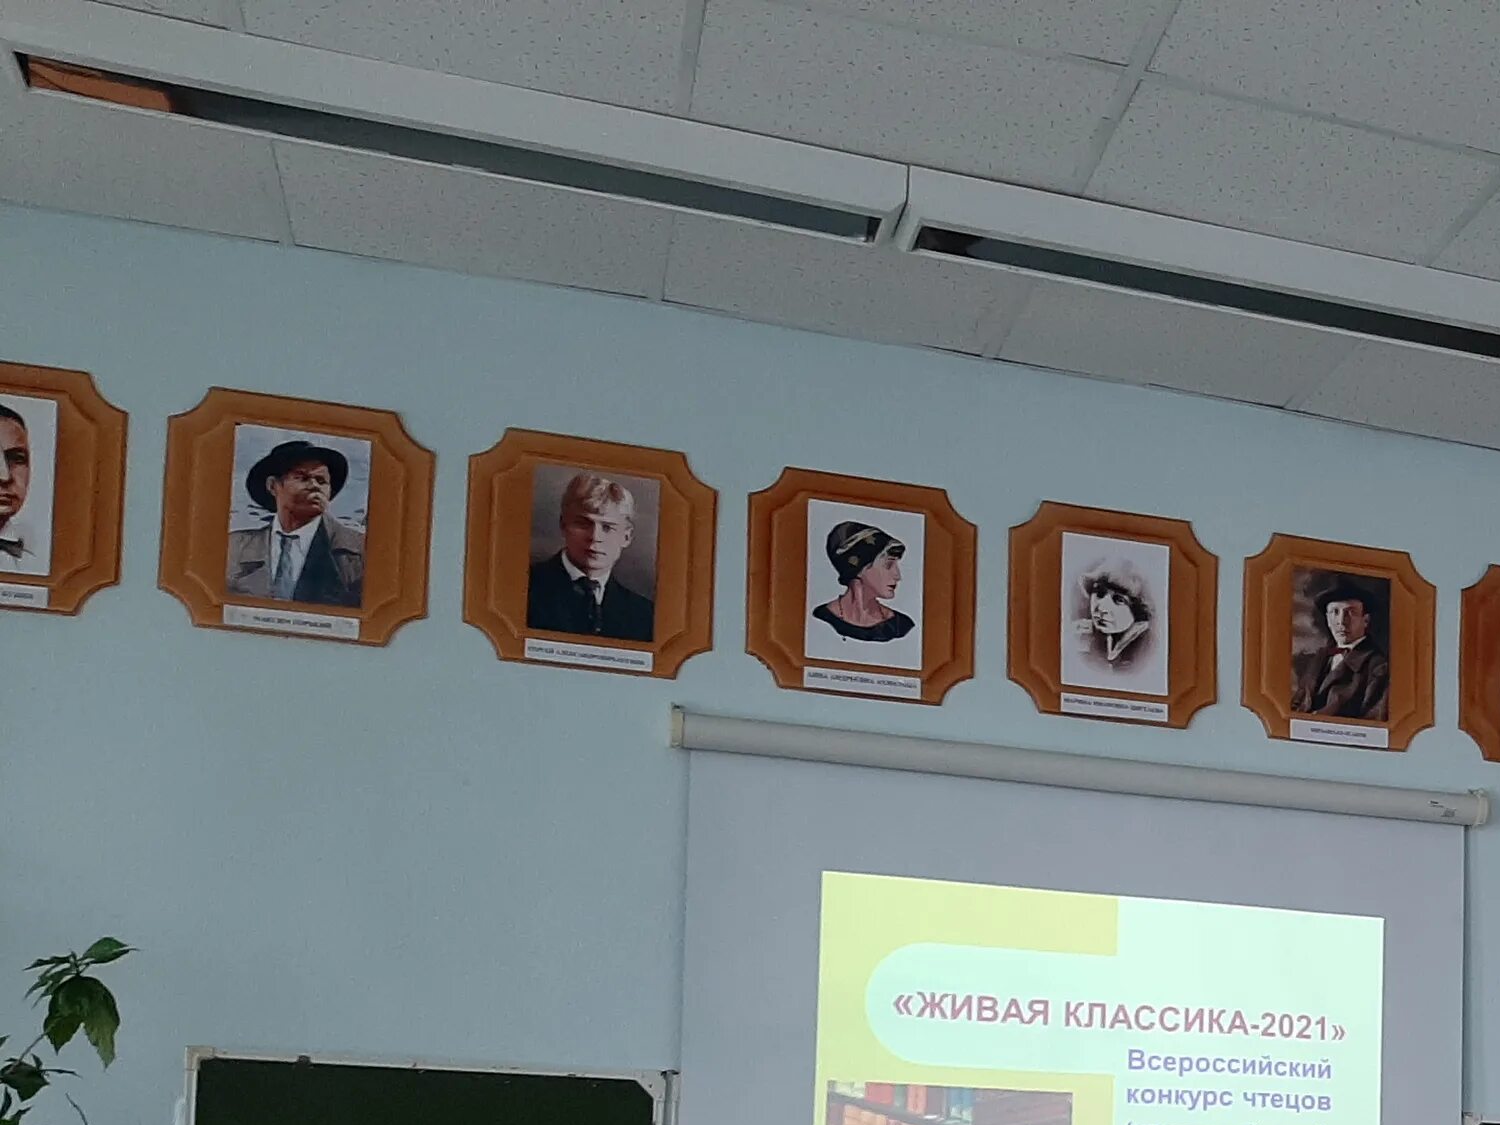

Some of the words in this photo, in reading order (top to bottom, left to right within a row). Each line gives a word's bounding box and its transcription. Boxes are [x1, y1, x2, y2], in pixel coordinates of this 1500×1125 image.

[893, 991, 1050, 1026] «ЖИВАЯ
[1064, 1001, 1347, 1041] КЛАССИКА-2021»
[1127, 1048, 1332, 1079] Всероссийский
[1126, 1087, 1233, 1111] конкурс
[1243, 1091, 1332, 1113] чтецов
